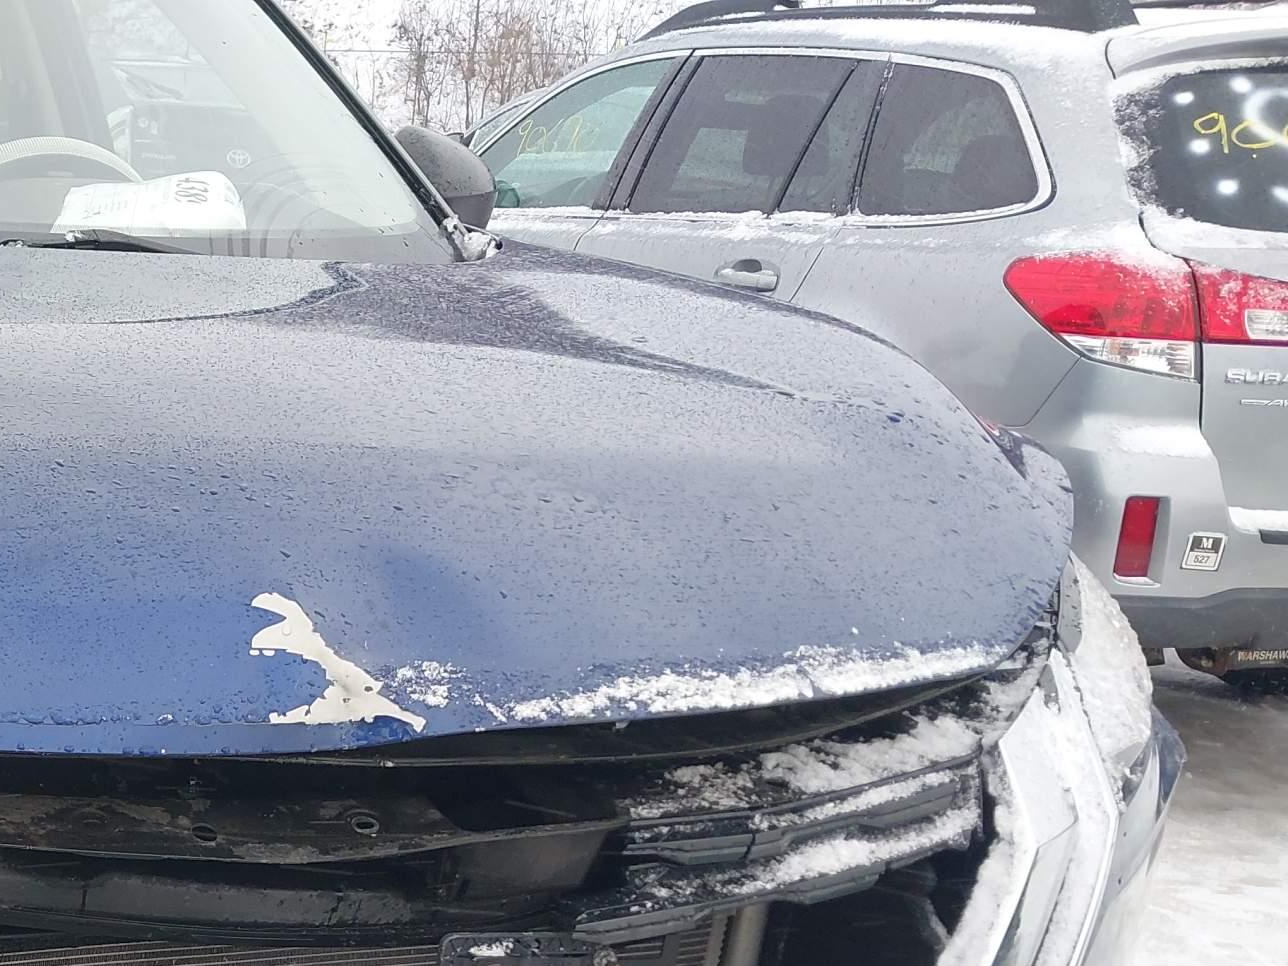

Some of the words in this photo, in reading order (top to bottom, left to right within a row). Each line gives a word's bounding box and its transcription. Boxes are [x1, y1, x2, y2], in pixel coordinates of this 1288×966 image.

[1192, 112, 1288, 154] 90
[1200, 537, 1214, 549] M
[1193, 554, 1210, 564] 527
